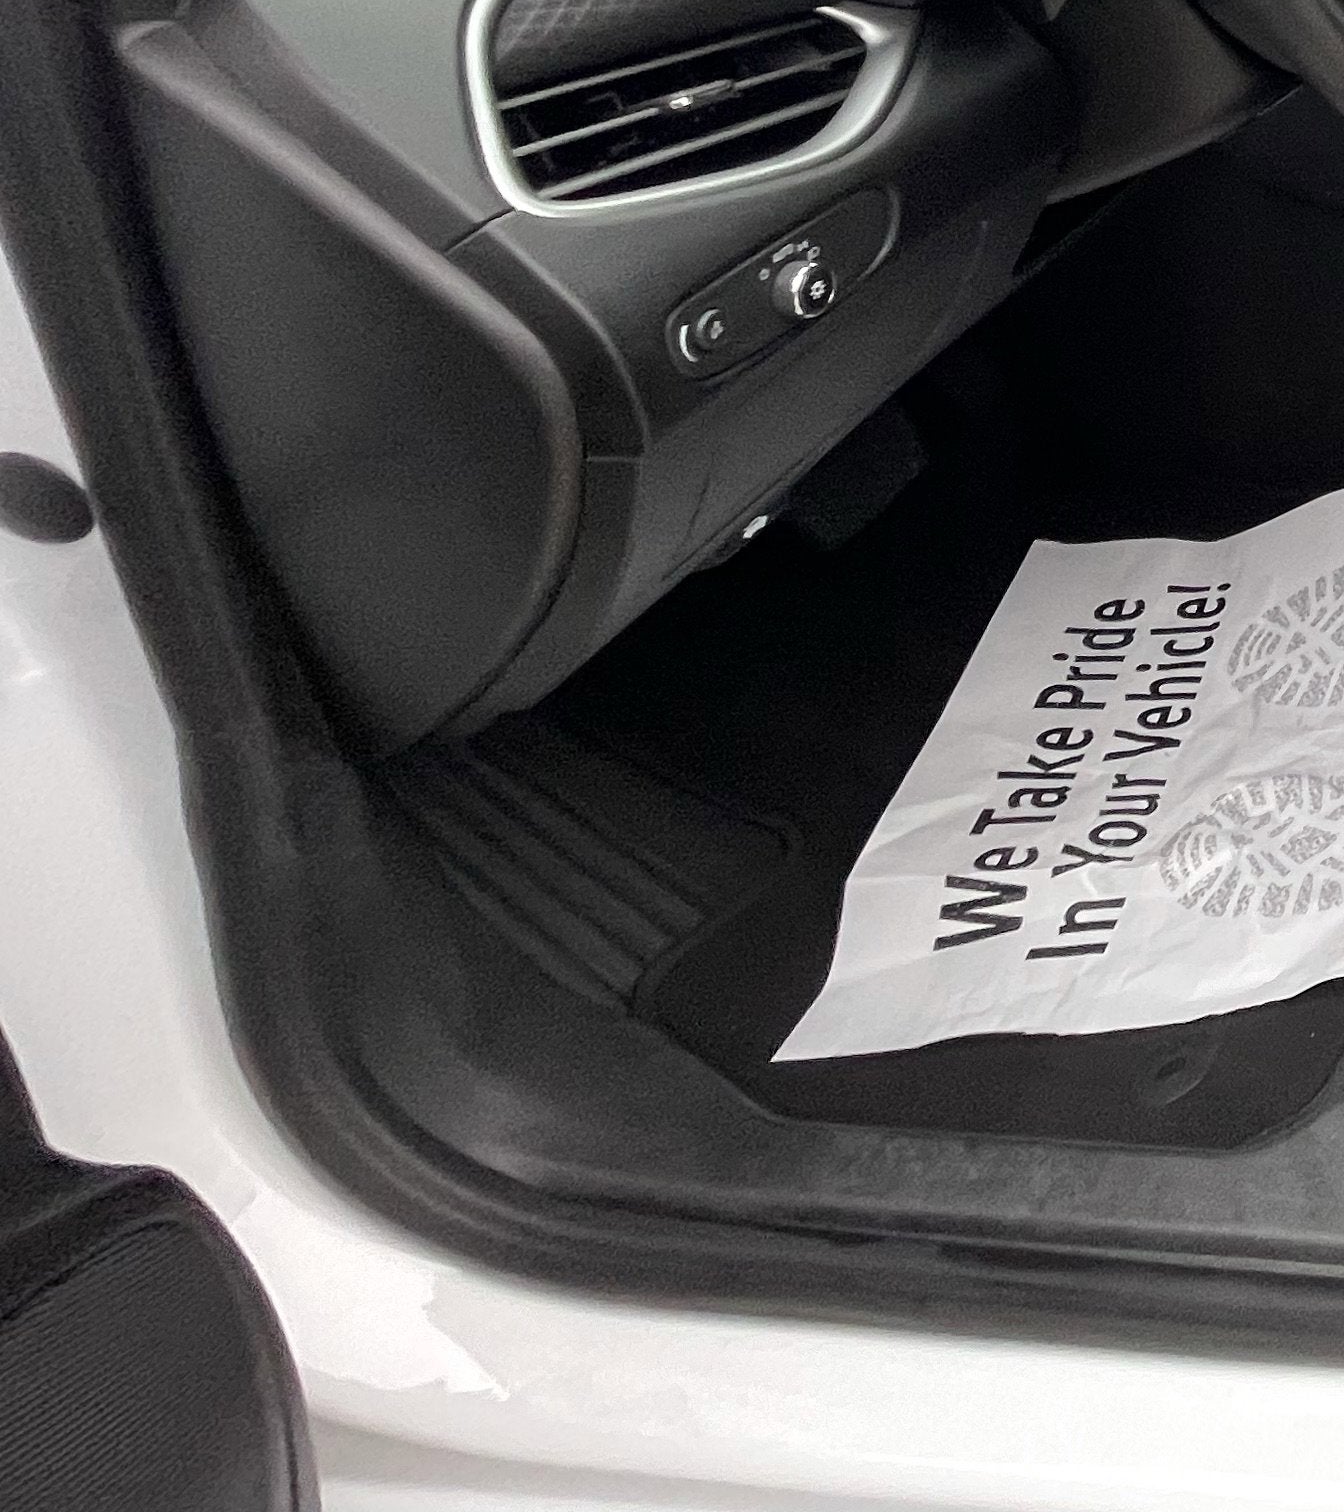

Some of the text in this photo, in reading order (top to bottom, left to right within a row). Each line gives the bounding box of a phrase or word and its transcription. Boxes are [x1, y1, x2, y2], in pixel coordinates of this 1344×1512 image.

[933, 598, 1145, 951] We Take Pride
[1025, 582, 1232, 960] In Your Vehicle!
